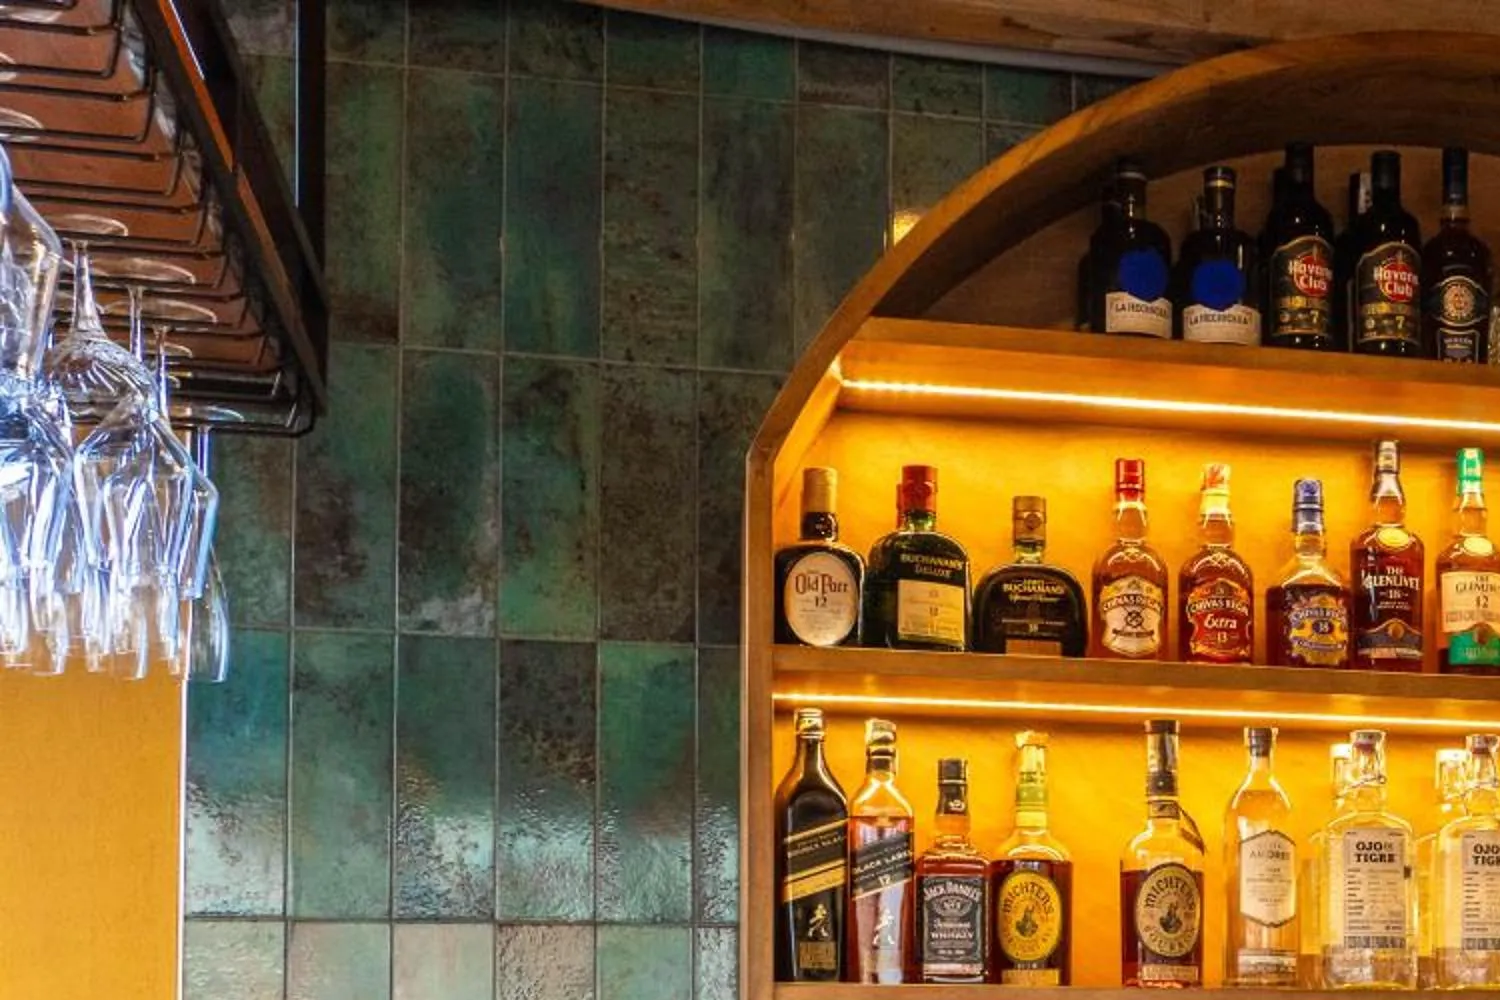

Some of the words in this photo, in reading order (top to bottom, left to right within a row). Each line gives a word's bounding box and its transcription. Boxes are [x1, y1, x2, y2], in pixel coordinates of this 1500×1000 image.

[1299, 274, 1328, 290] Club
[1385, 281, 1414, 297] Club
[795, 573, 819, 594] Old
[821, 574, 848, 594] Parr
[1203, 613, 1238, 629] Extra
[1356, 841, 1383, 851] OJO
[1474, 844, 1499, 854] OJO
[1355, 853, 1395, 863] TIGRE
